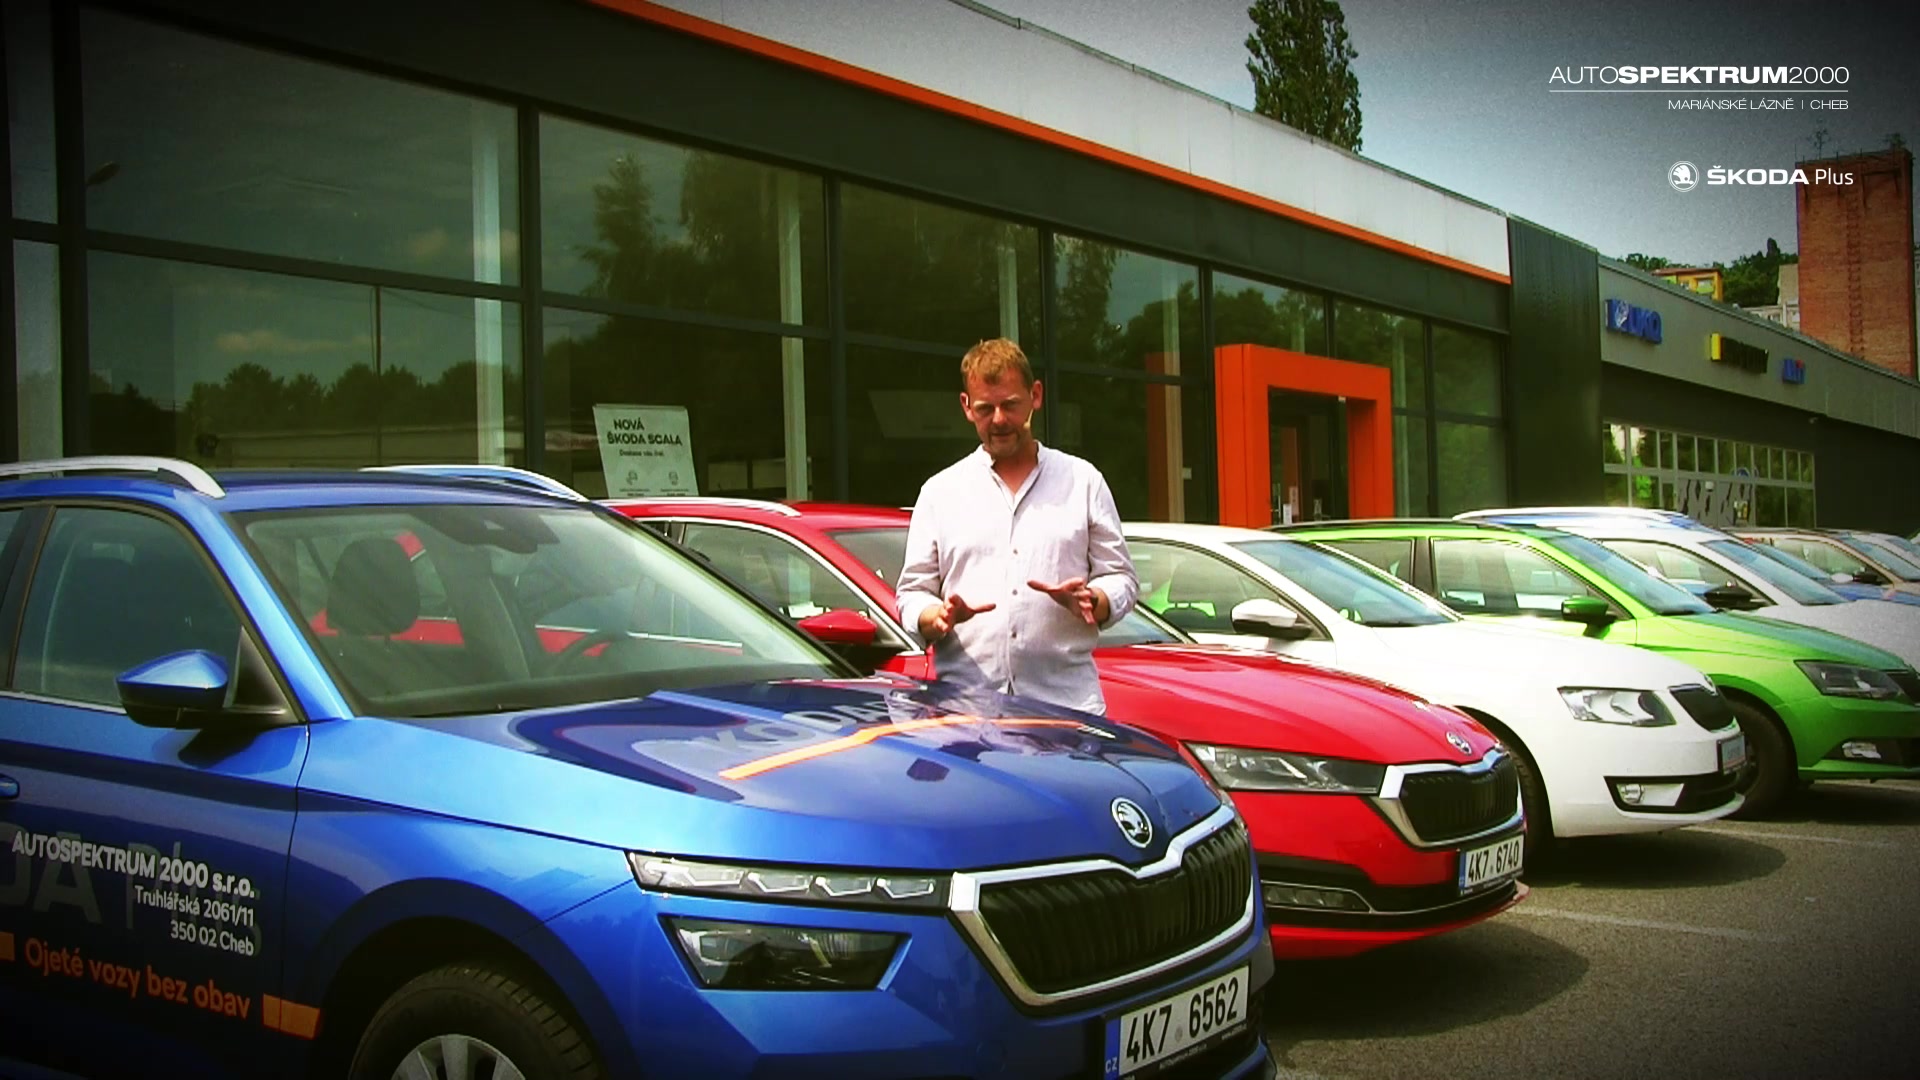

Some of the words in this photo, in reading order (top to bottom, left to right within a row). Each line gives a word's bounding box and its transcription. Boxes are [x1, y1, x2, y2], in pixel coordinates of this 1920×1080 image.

[607, 432, 646, 445] ŠKODA
[648, 434, 682, 446] SCALA
[613, 417, 645, 430] NOVÁ
[12, 830, 155, 879] AUTOSPEKTRUM
[159, 857, 208, 889] 2000
[212, 872, 255, 898] s.r.o.
[1468, 849, 1490, 882] 4K7
[1495, 840, 1520, 874] 6740
[134, 884, 200, 916] Truhlářská
[203, 898, 255, 927] 2061/11
[170, 919, 197, 943] 350
[199, 926, 217, 948] 02
[219, 930, 255, 957] Cheb
[24, 936, 84, 977] Ojeté
[88, 957, 141, 999] vozy
[146, 963, 189, 1005] bez
[193, 978, 251, 1020] obav
[1126, 1003, 1173, 1064] 4K7
[1188, 976, 1239, 1039] 6562
[1105, 1056, 1118, 1074] CZ
